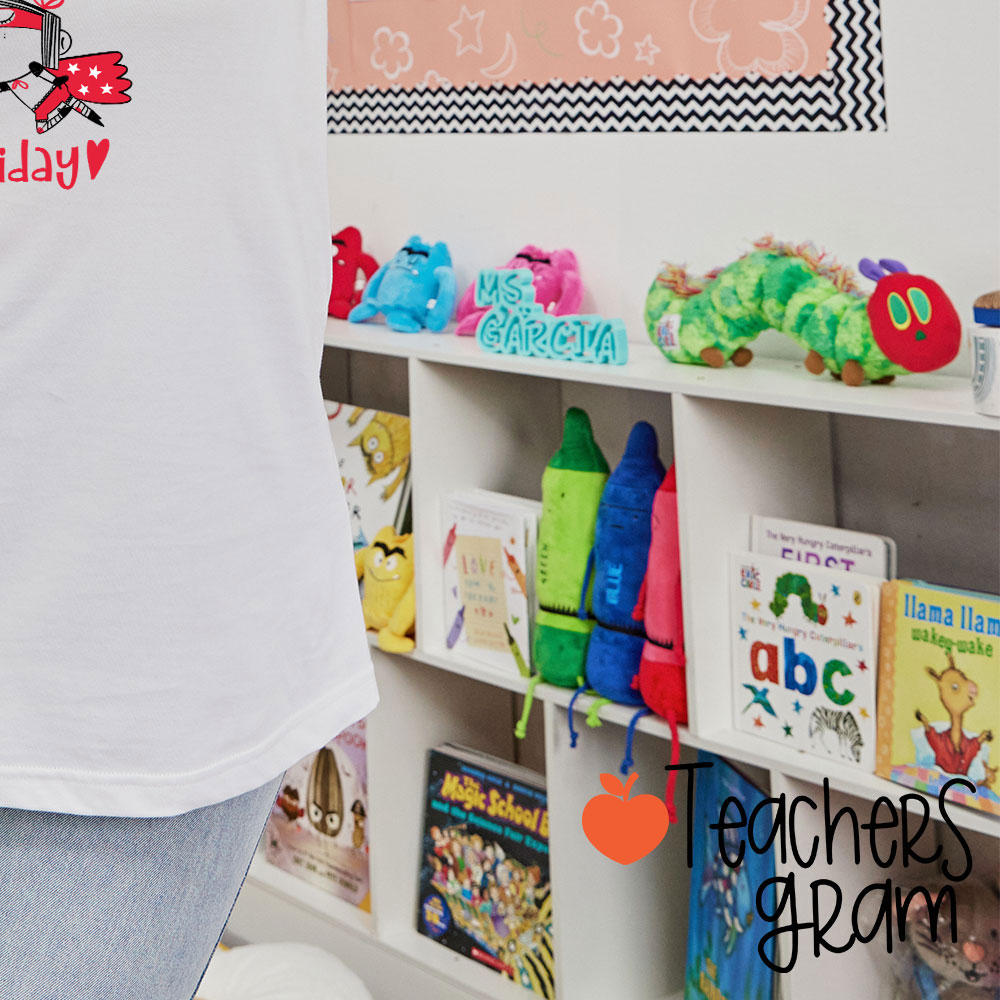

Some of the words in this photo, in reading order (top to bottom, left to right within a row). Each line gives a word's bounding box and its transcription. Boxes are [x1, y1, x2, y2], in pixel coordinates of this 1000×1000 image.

[479, 311, 618, 363] GARCIA
[905, 593, 954, 627] llama
[961, 605, 1000, 637] llam
[750, 636, 855, 706] abc
[440, 772, 487, 811] Magic
[486, 789, 540, 832] School
